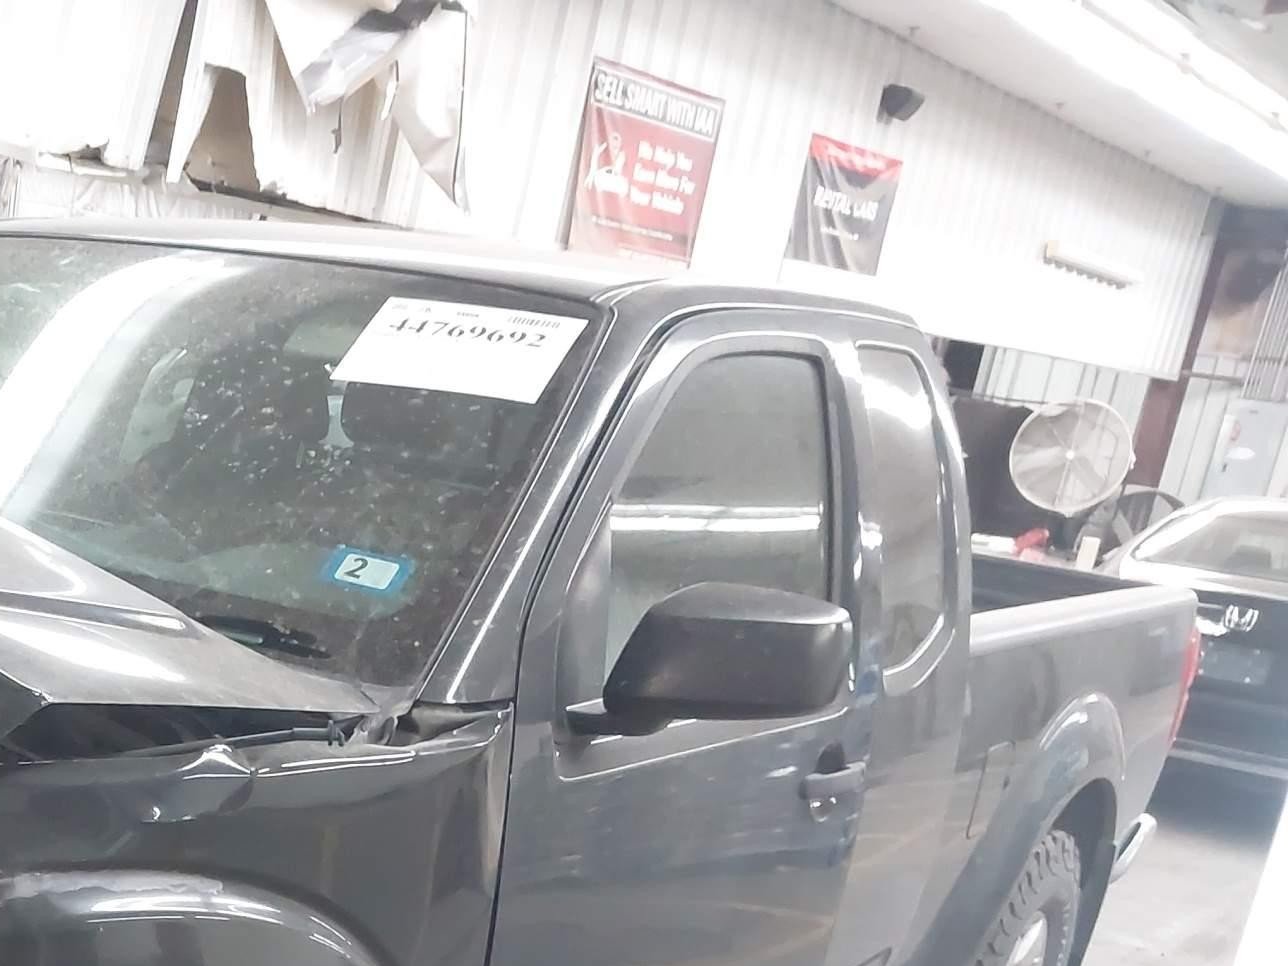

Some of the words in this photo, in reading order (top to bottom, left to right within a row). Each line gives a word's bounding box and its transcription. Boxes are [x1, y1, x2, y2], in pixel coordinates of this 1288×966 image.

[594, 71, 625, 106] SELL
[624, 82, 668, 119] SMART
[666, 95, 697, 130] WITH
[389, 317, 547, 348] 44769692
[344, 557, 369, 579] 2
